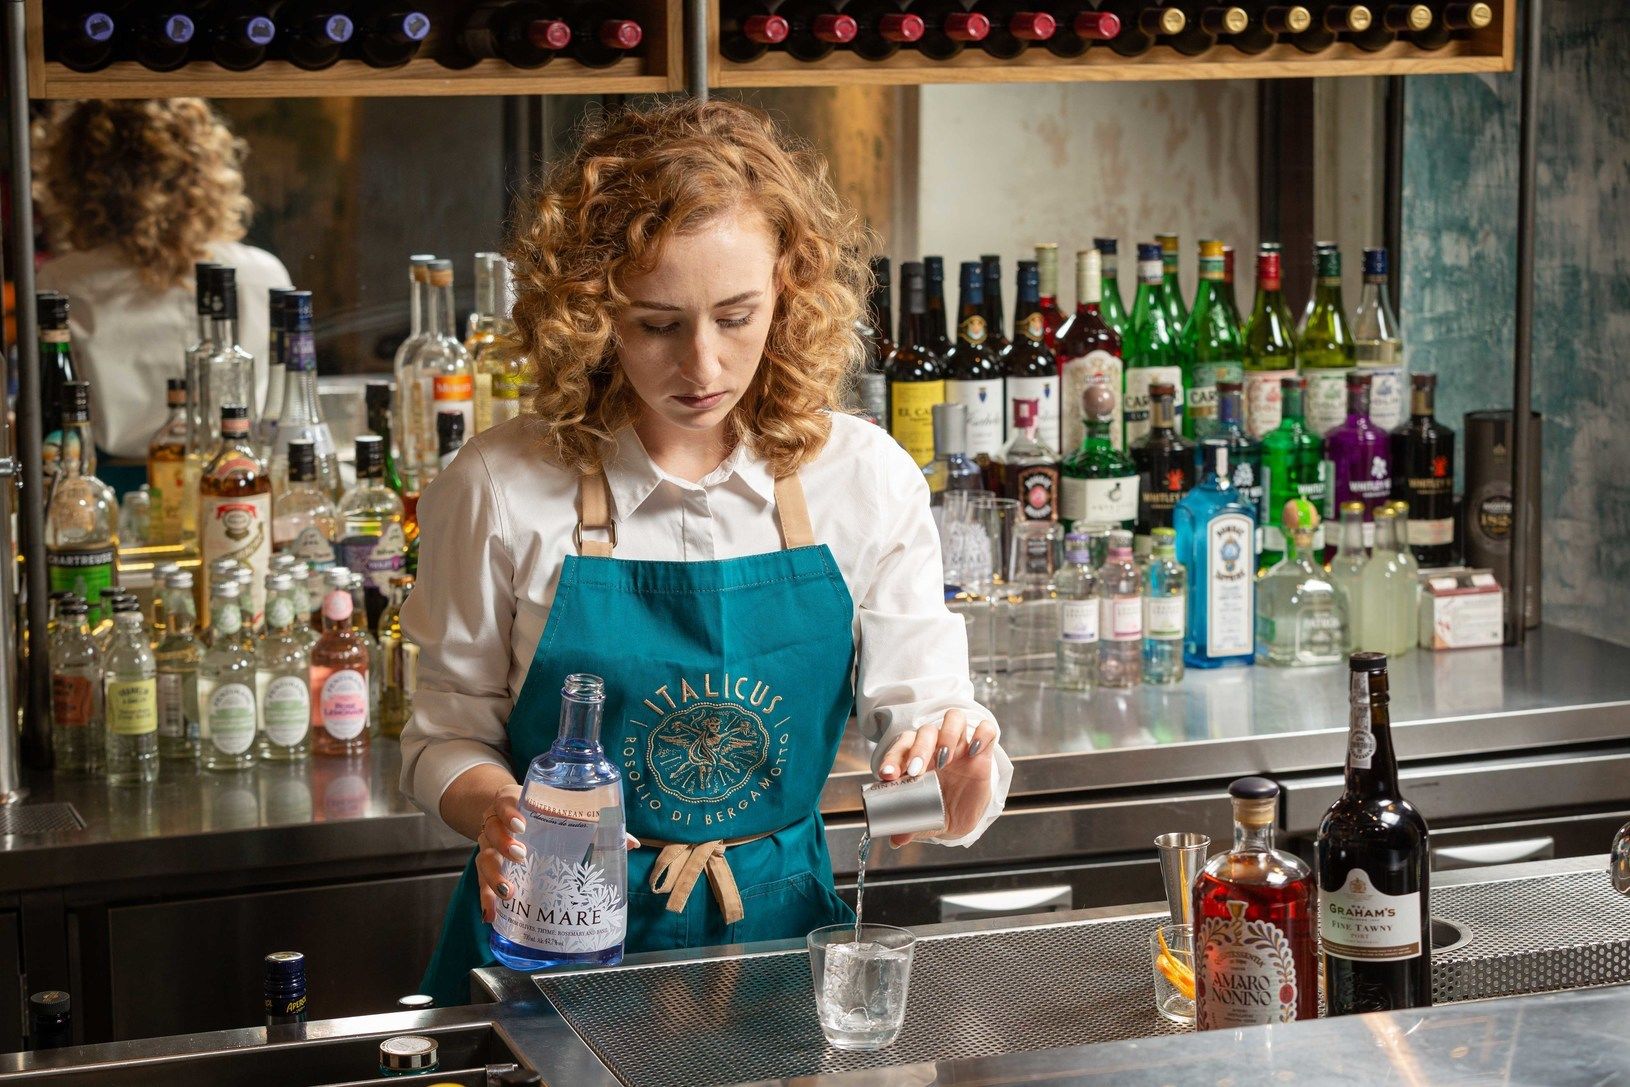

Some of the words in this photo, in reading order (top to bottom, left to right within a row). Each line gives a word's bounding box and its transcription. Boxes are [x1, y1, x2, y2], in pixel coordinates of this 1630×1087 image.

[643, 672, 783, 716] ITALICUS
[623, 736, 662, 810] ROSOLIO
[672, 810, 692, 826] DI
[704, 733, 789, 826] BERGAMOTTO
[501, 898, 530, 919] GIN
[536, 908, 602, 927] MARE
[1329, 902, 1397, 918] GRAHAM'S
[1331, 920, 1353, 931] FINE
[1356, 923, 1394, 933] TAWNY
[1212, 971, 1271, 992] AMARO
[286, 994, 307, 1014] APERO
[1211, 986, 1272, 1007] NONINO
